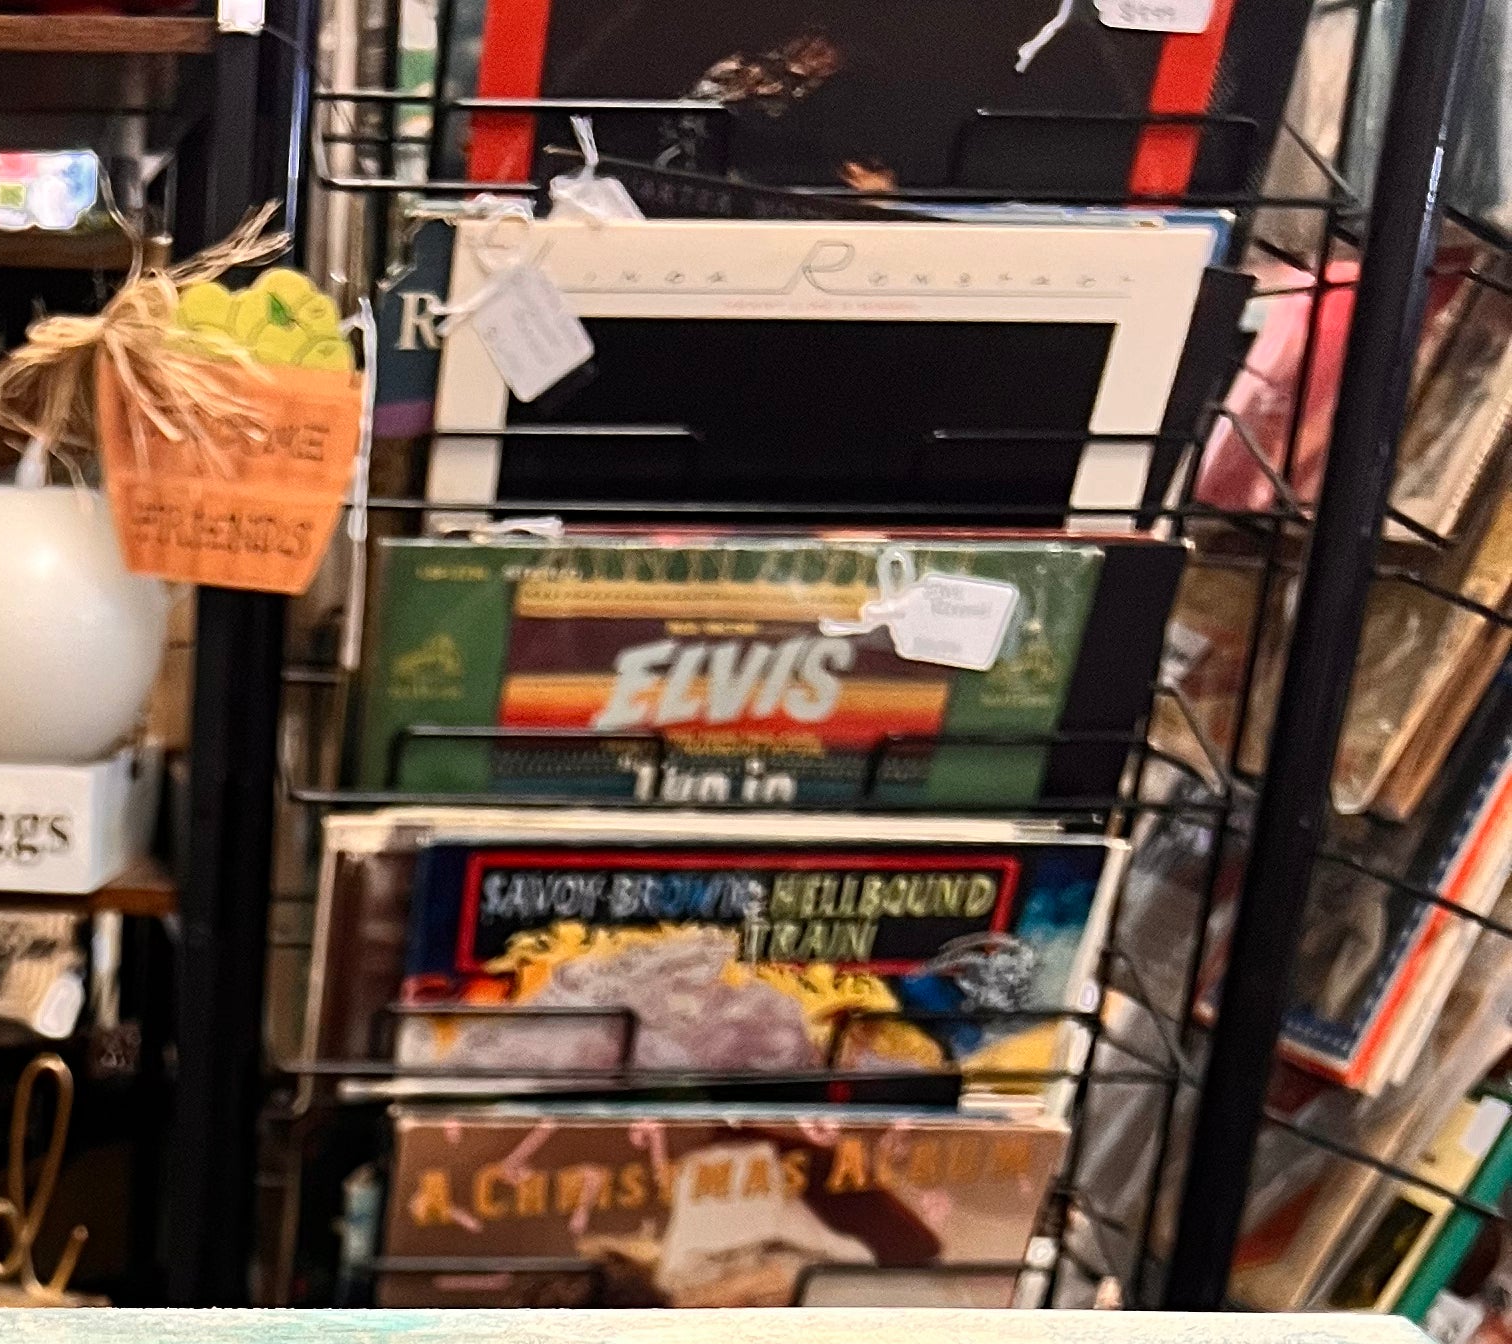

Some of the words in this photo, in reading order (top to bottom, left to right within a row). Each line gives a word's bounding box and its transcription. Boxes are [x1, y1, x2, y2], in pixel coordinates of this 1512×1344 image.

[591, 634, 856, 732] ELVIS
[482, 868, 608, 922] SAVOY
[769, 870, 998, 921] HELLBOUND
[743, 917, 879, 965] TRAIN
